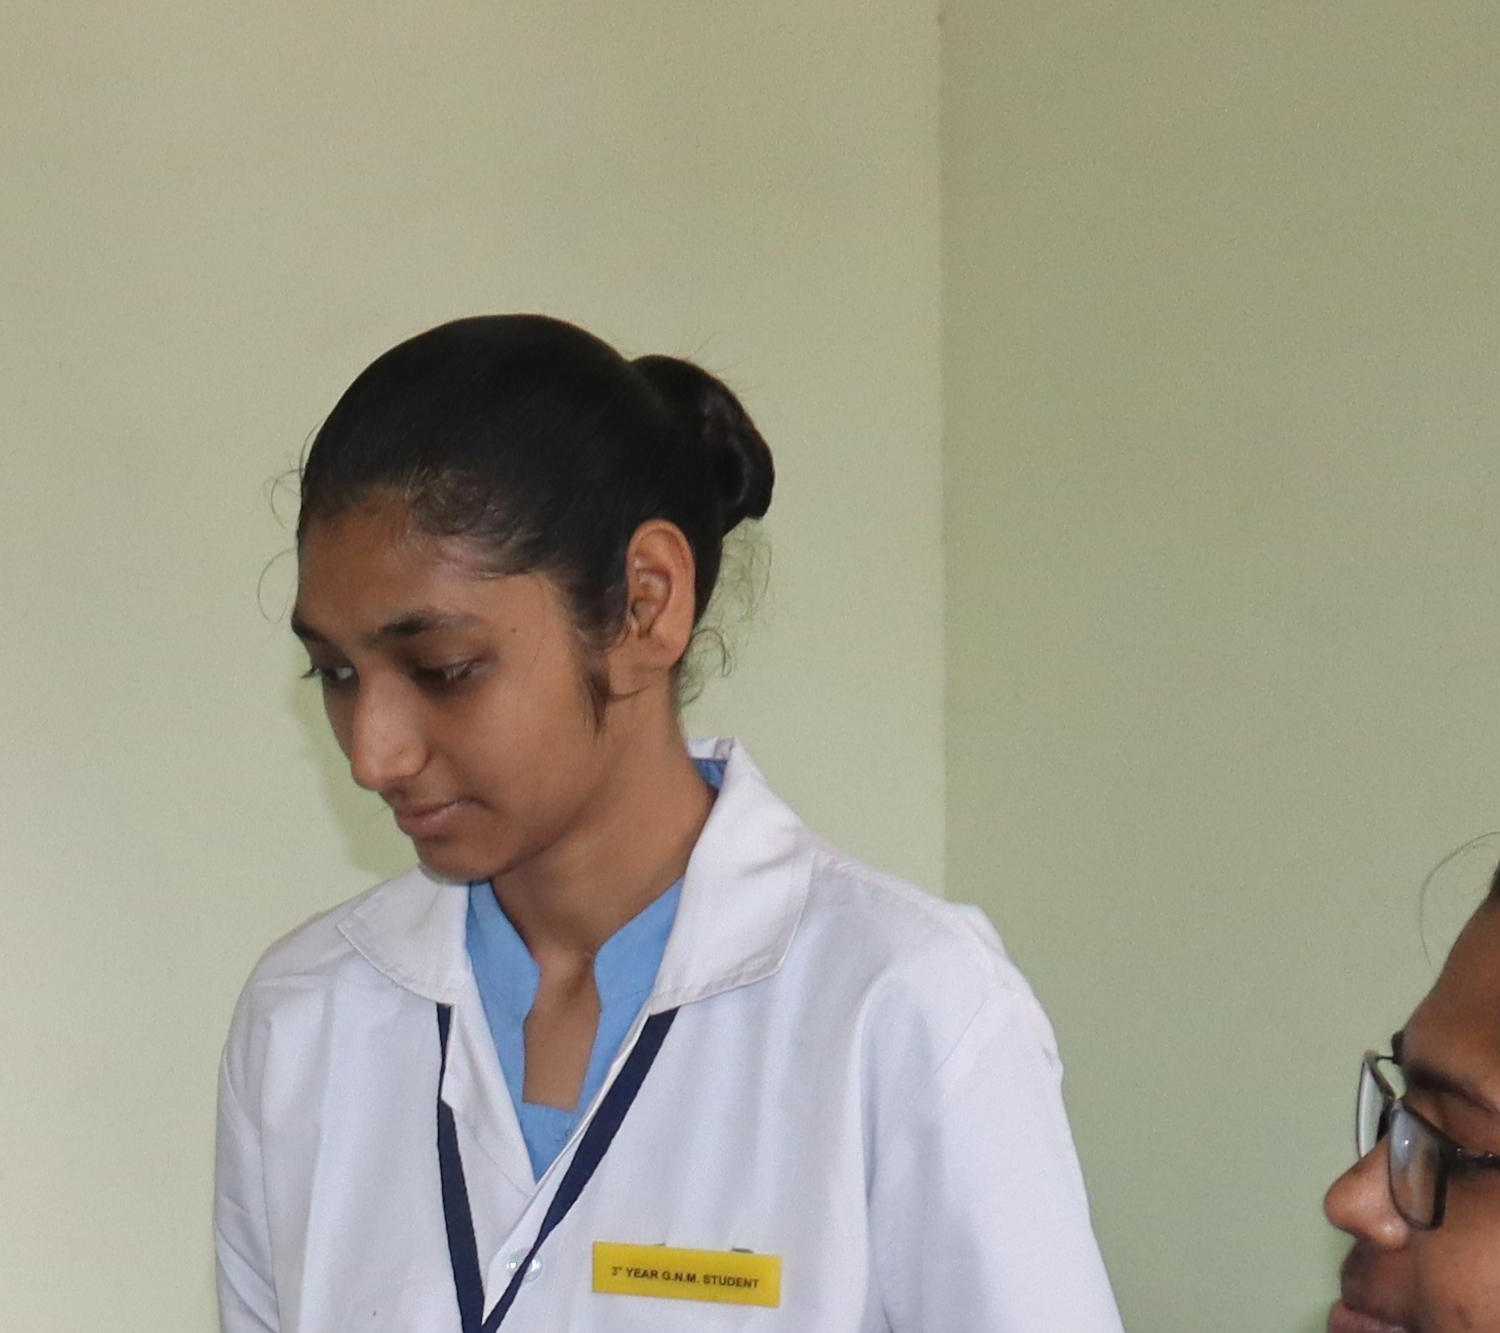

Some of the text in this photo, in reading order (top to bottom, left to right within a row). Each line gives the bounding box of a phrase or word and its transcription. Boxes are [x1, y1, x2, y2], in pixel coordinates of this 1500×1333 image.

[626, 1267, 658, 1280] YEAR
[662, 1270, 699, 1283] G.N.M.
[703, 1274, 759, 1289] STUDENT
